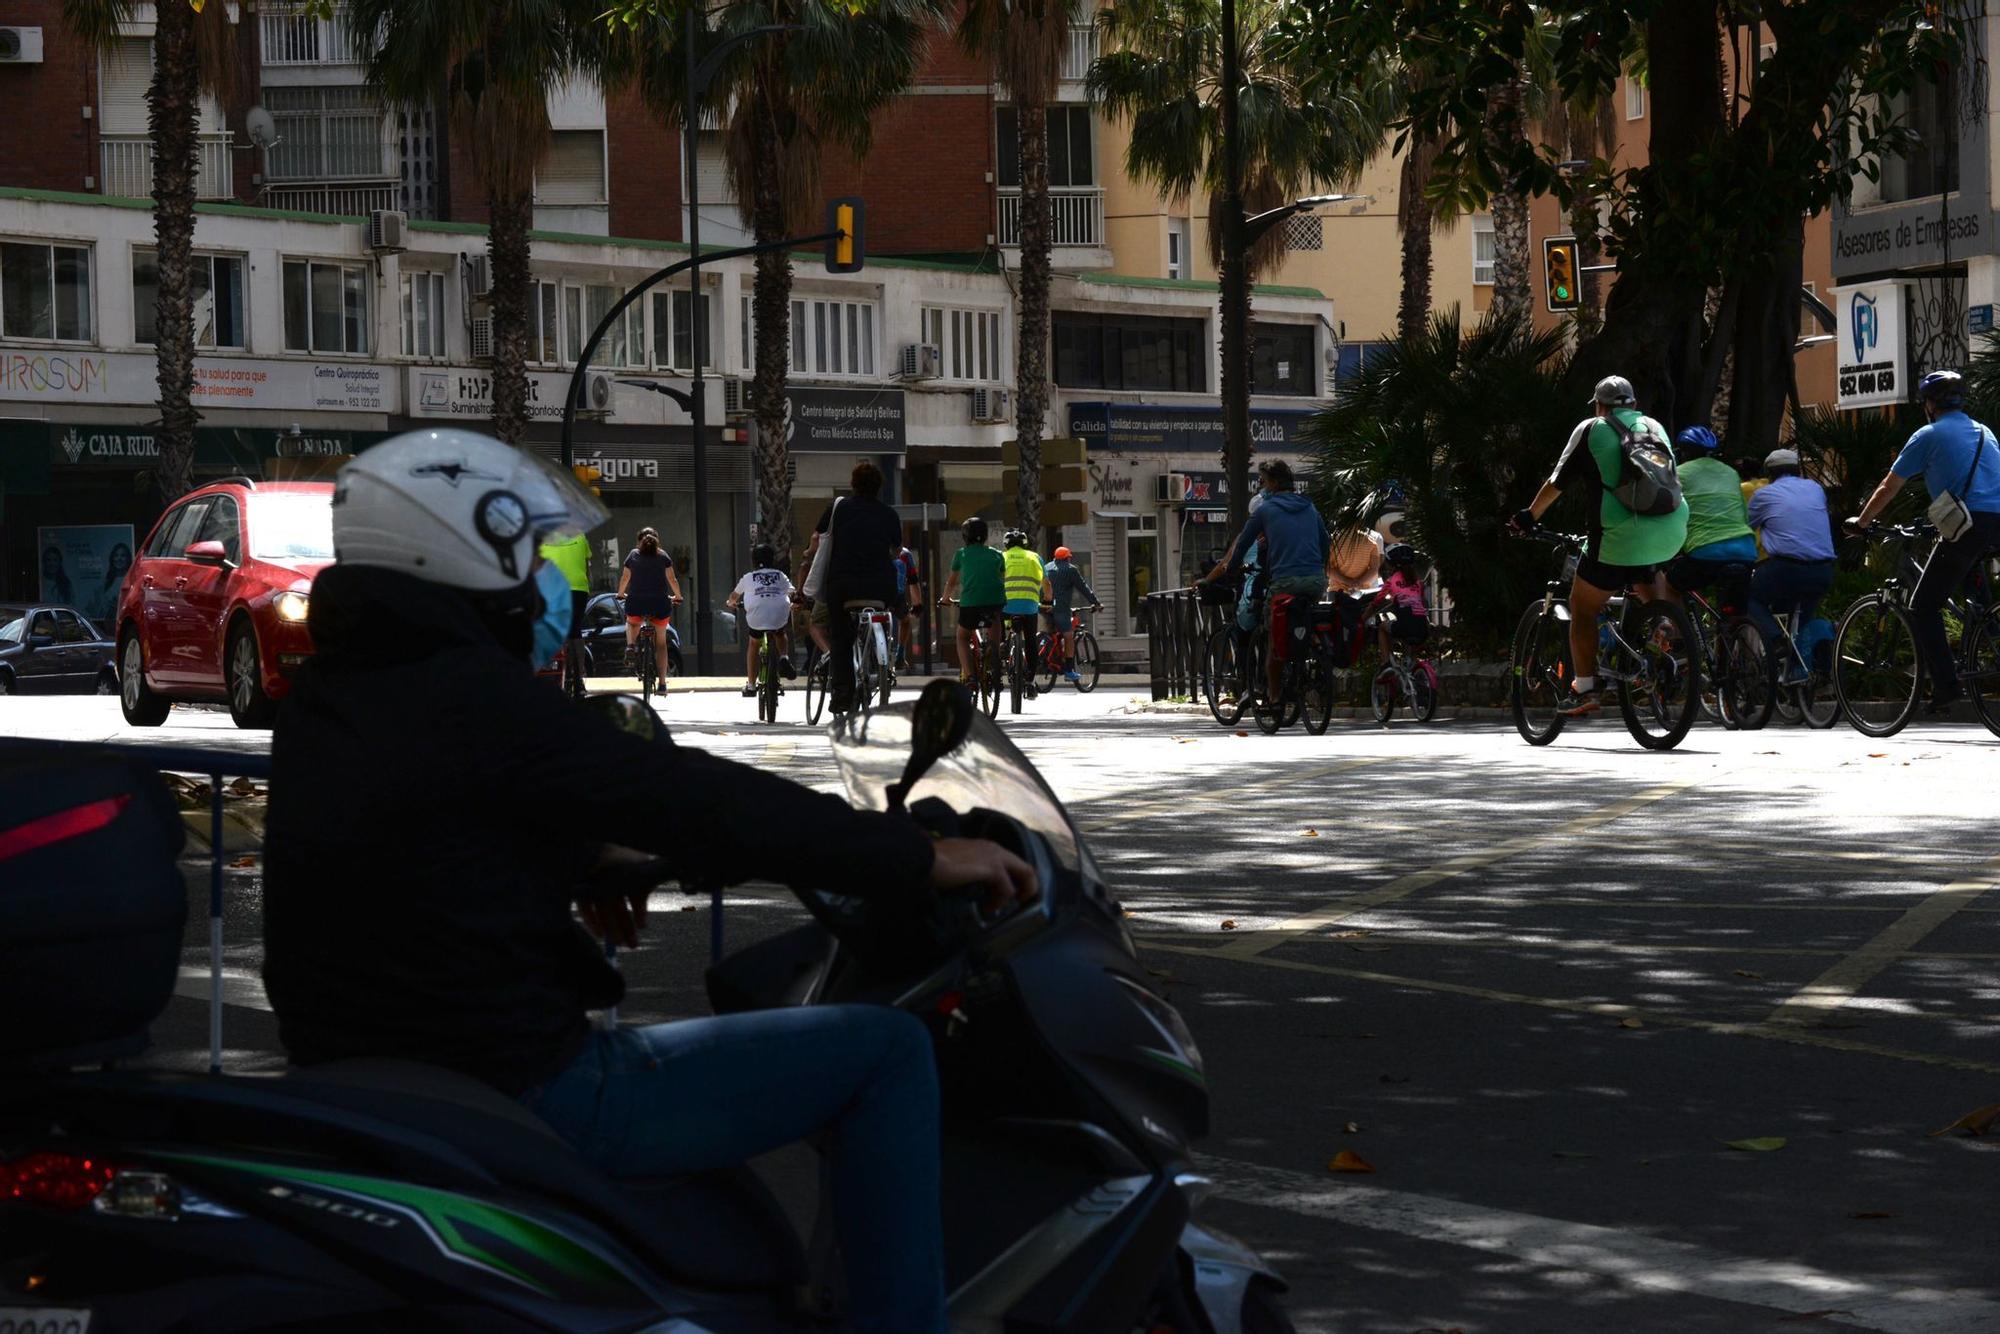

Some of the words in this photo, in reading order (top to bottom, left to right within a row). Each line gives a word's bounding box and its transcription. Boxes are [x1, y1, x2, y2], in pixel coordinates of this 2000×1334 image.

[1836, 230, 1891, 258] Asesores
[1895, 220, 1912, 248] de
[0, 355, 107, 393] IROSUM
[208, 368, 230, 380] salud
[231, 371, 251, 383] para
[251, 372, 267, 384] que
[315, 366, 335, 378] Centro
[208, 384, 254, 397] plenamente
[1840, 376, 1857, 396] 952
[451, 401, 497, 414] Suministro
[801, 405, 822, 417] Centro
[823, 406, 847, 420] Integral
[855, 405, 873, 418] Salud
[878, 407, 901, 418] Belleza
[811, 427, 831, 438] Centro
[882, 428, 894, 441] Spa
[1250, 419, 1284, 442] Cálida
[88, 434, 125, 456] CAJA
[126, 435, 160, 457] RUR
